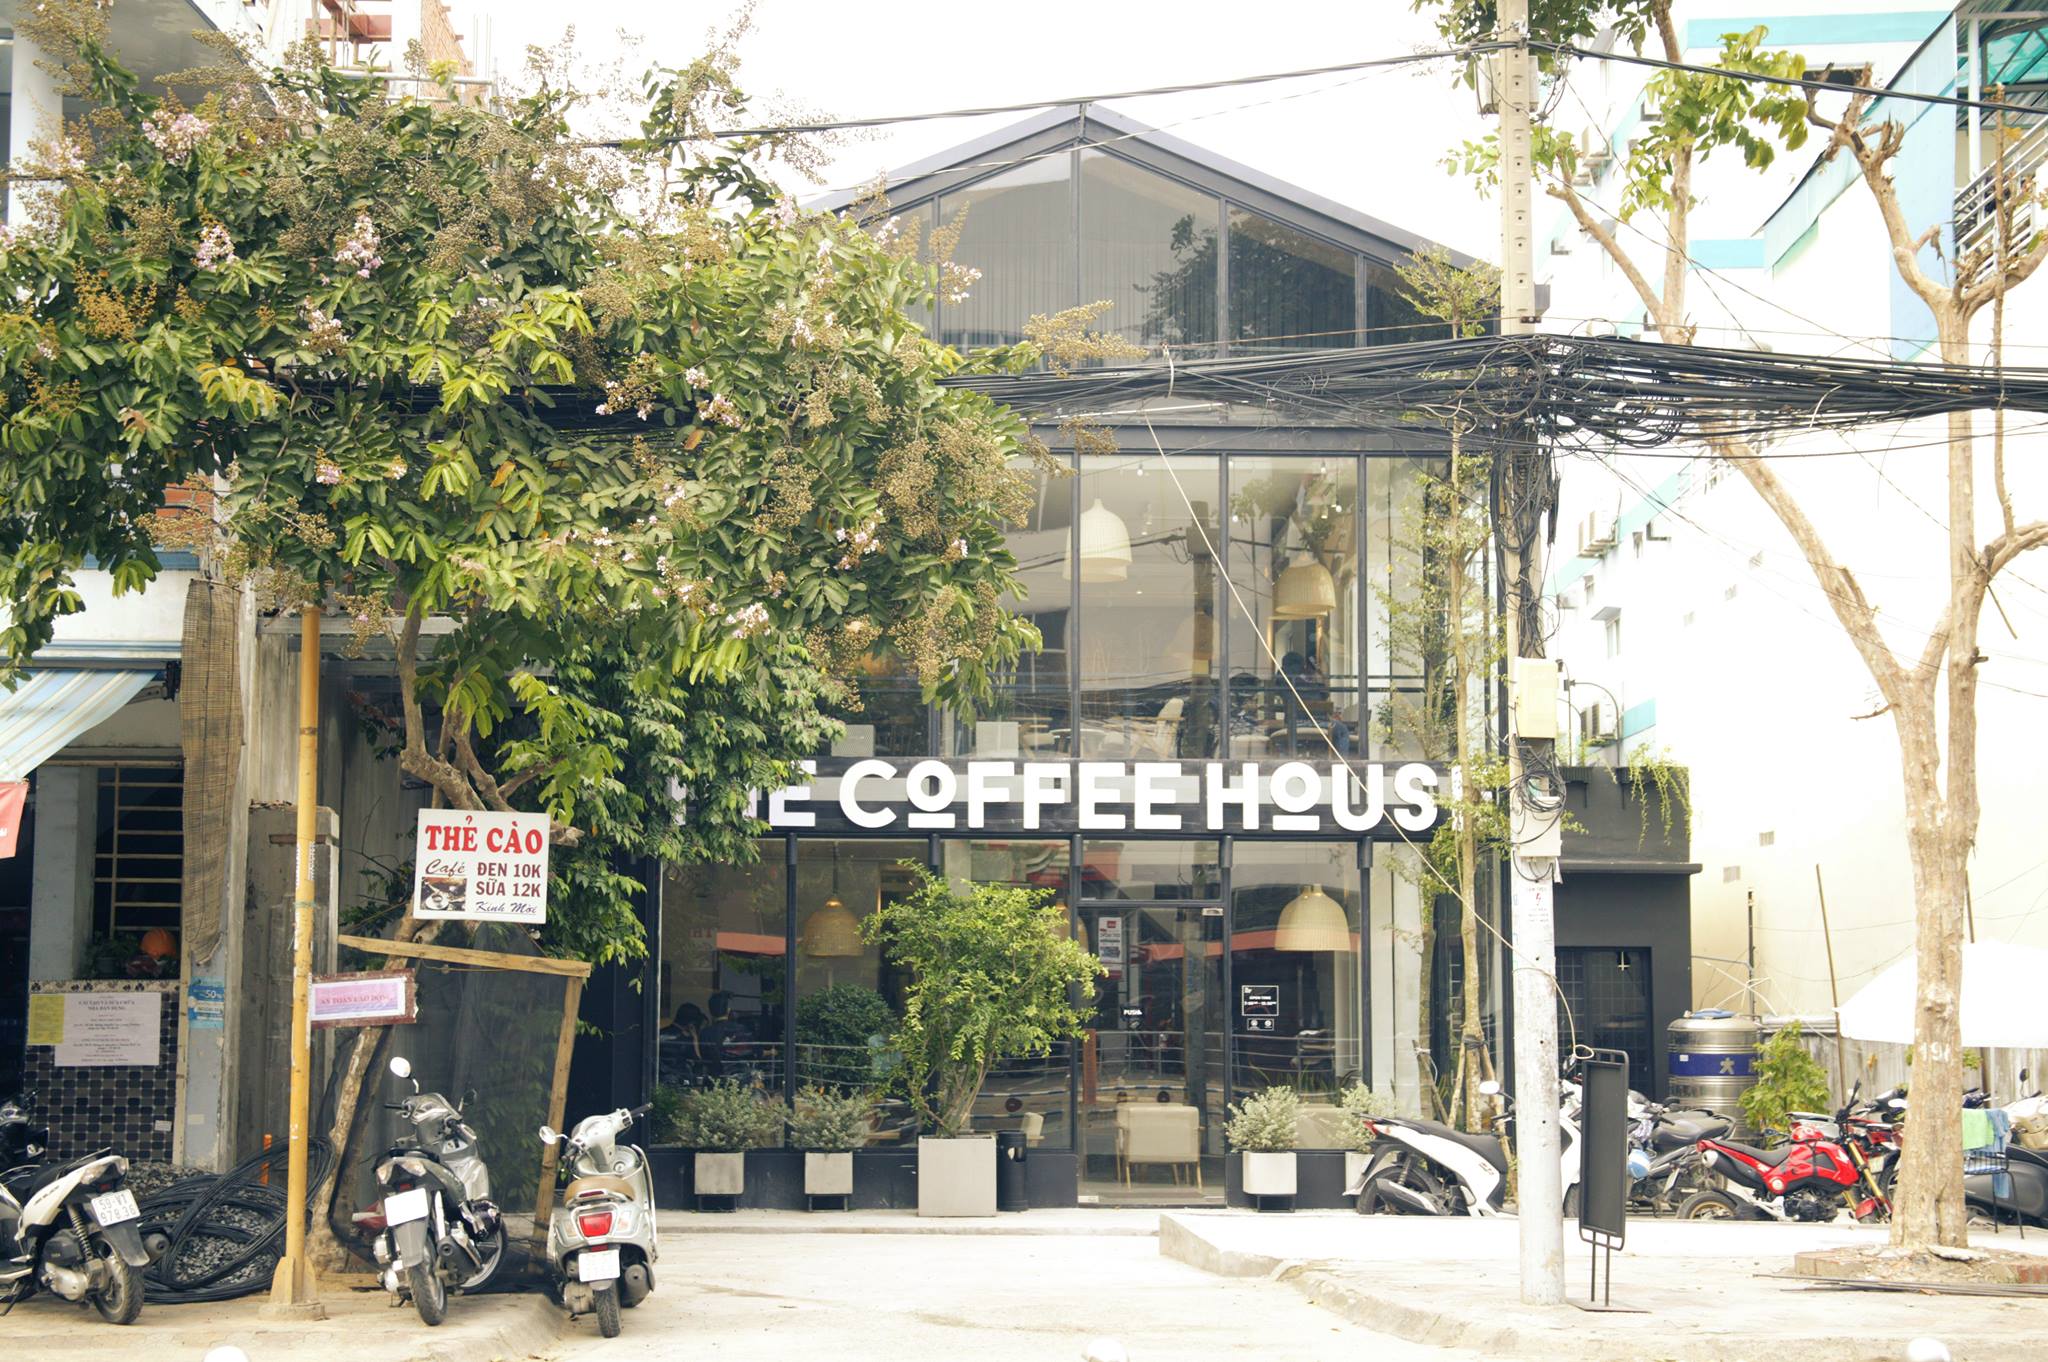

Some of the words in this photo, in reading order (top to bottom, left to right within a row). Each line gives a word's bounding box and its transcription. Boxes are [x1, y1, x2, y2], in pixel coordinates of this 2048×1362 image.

[839, 759, 1182, 829] COFFEE
[1206, 762, 1464, 831] HOUS
[424, 815, 478, 852] THẺ
[486, 821, 543, 855] CÀO
[477, 861, 508, 877] ĐEN
[513, 863, 541, 879] 10K
[476, 878, 506, 896] SỮA
[512, 883, 541, 898] 12K
